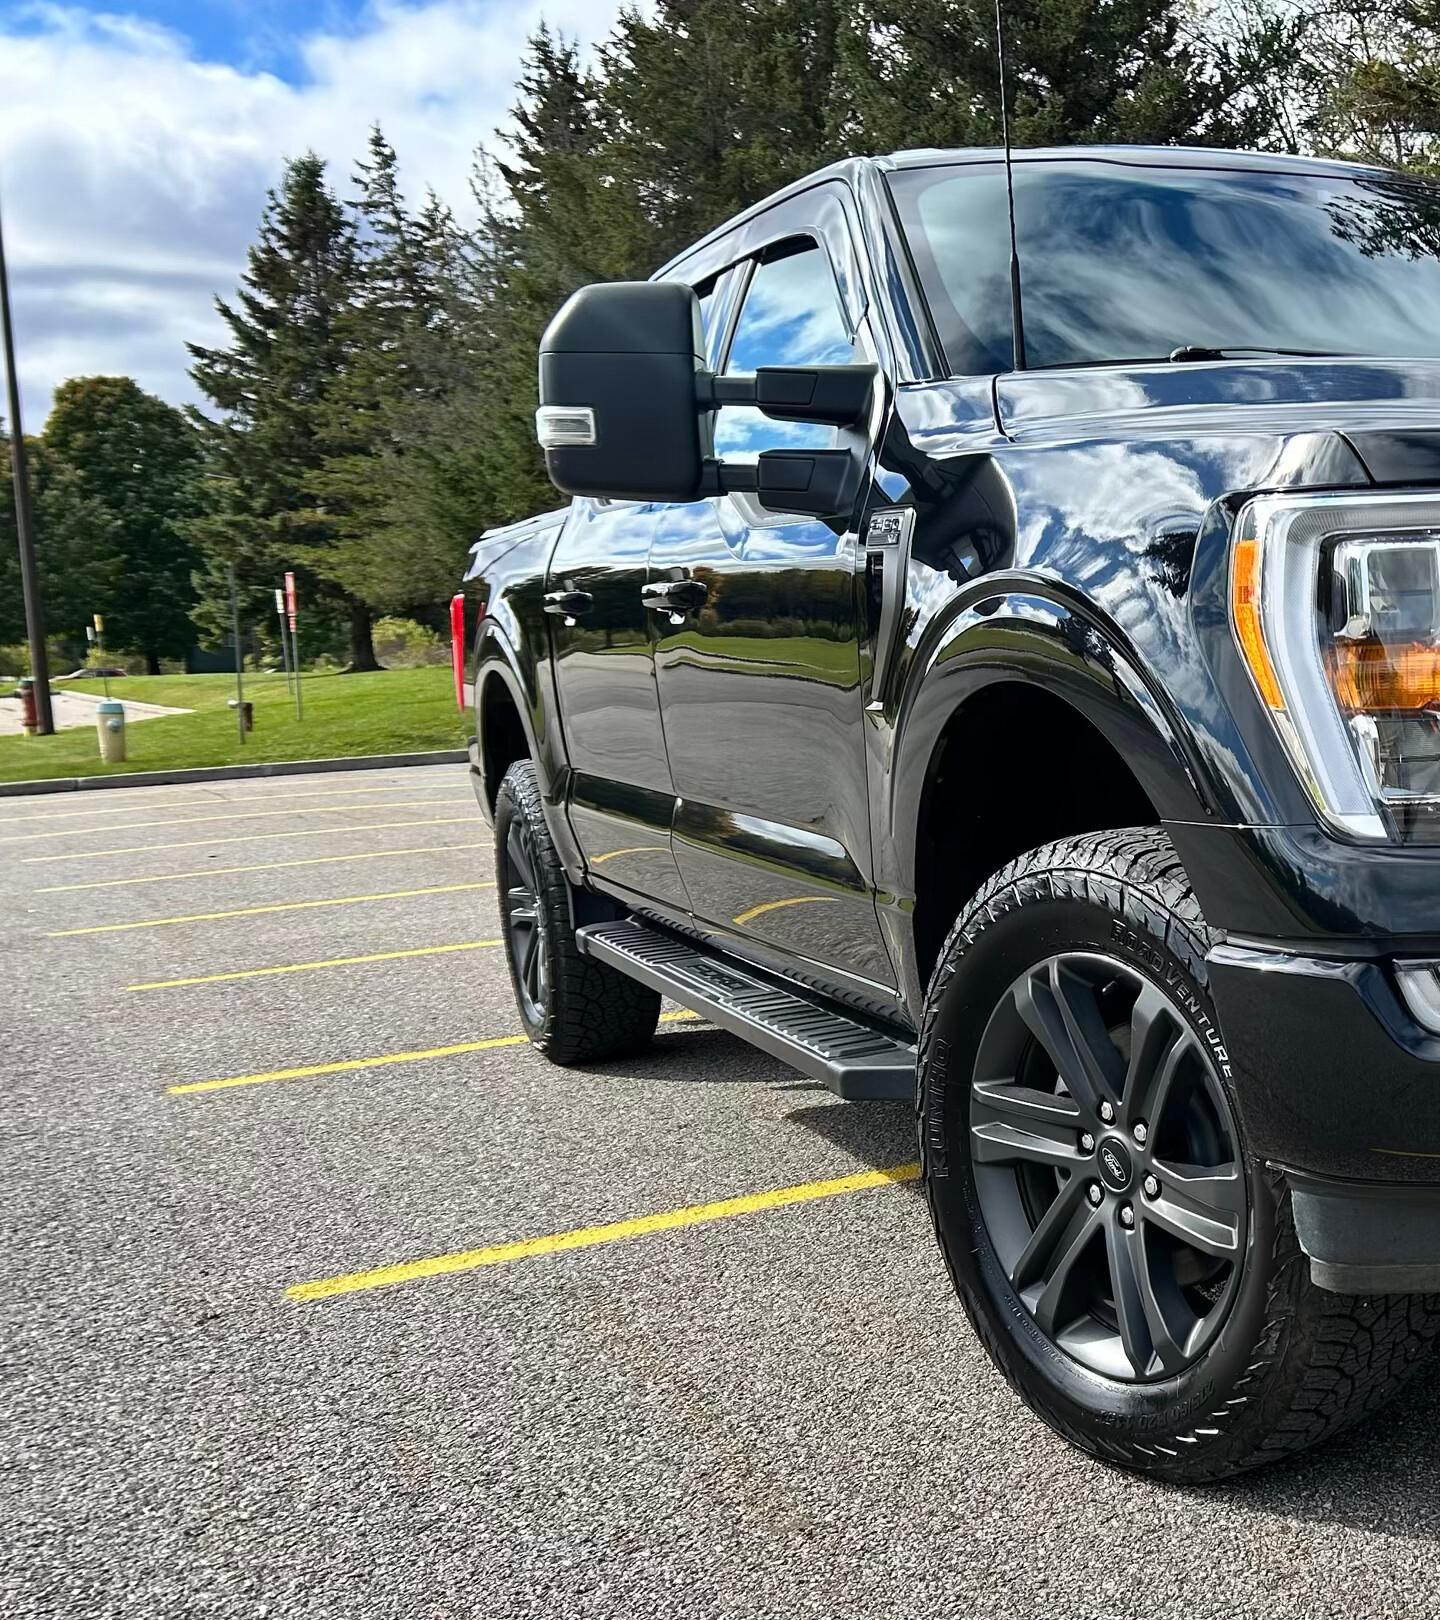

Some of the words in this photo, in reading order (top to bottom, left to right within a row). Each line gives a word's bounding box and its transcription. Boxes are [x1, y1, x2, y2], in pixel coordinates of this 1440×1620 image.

[1110, 918, 1233, 1079] ROADVENTURE
[928, 1037, 952, 1179] KUMHO
[1104, 1154, 1122, 1177] Ford
